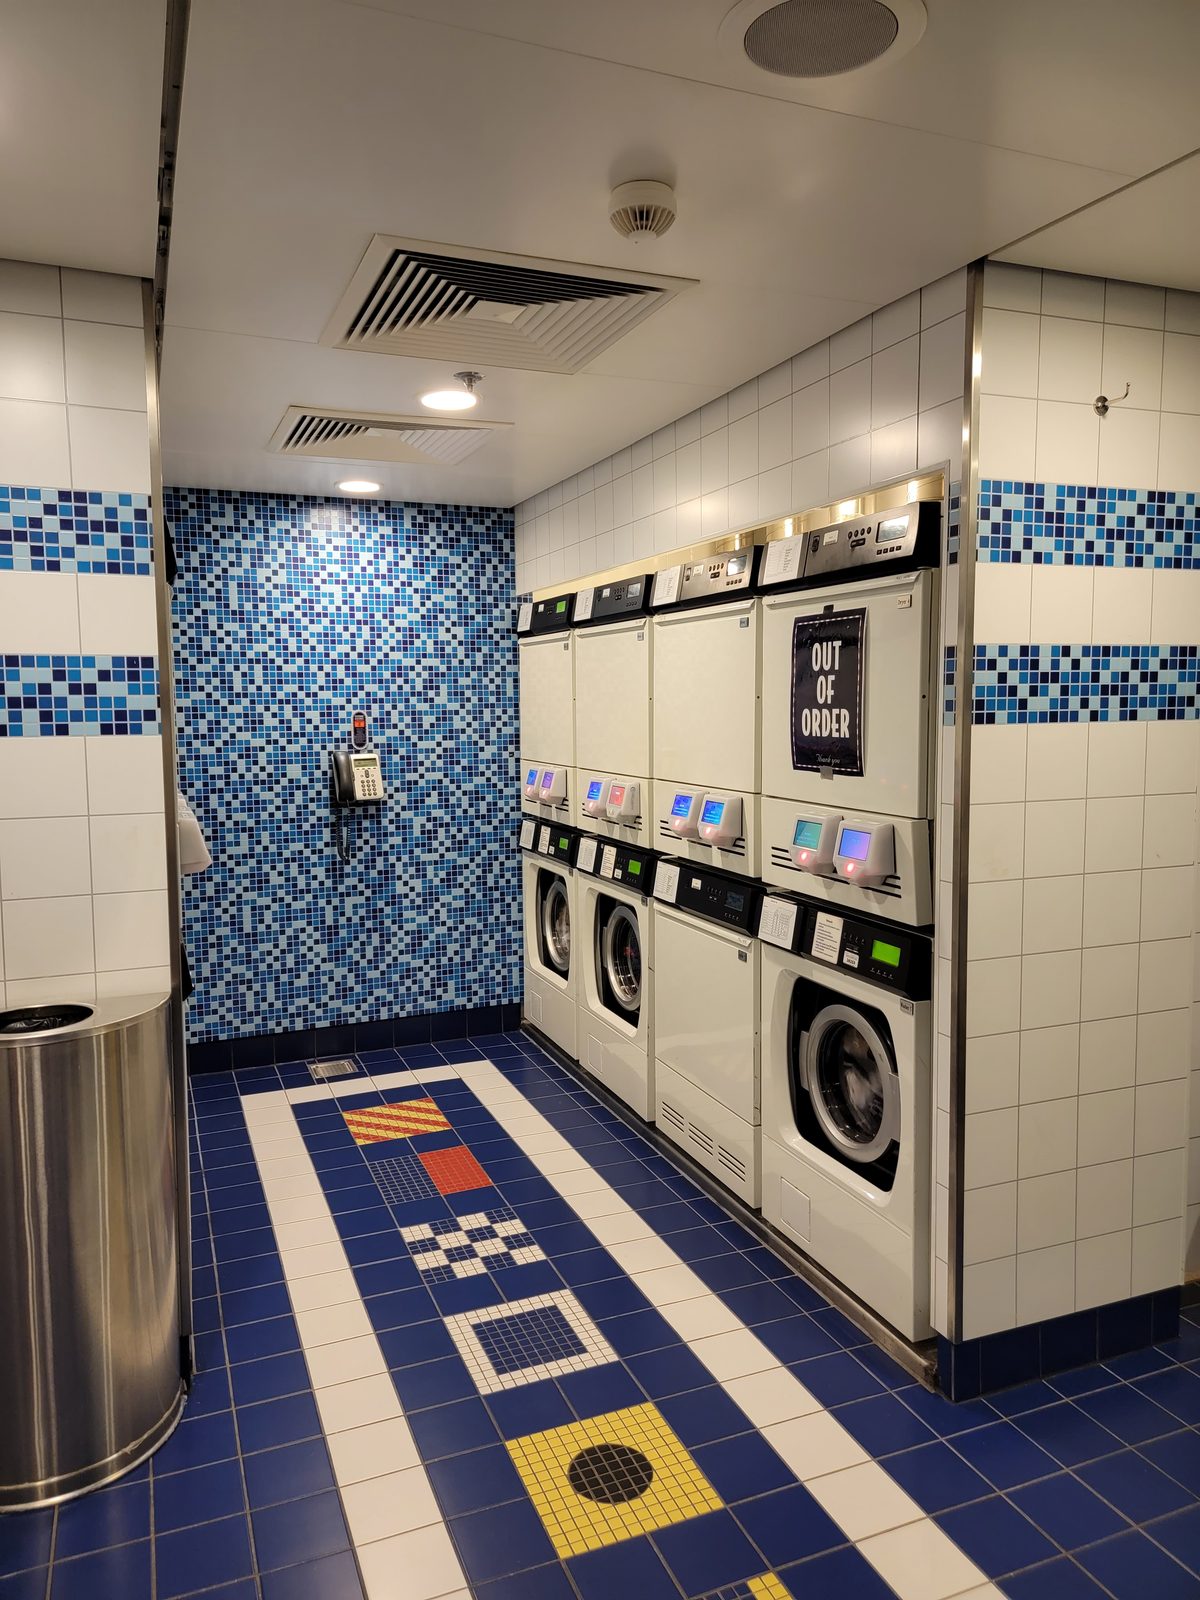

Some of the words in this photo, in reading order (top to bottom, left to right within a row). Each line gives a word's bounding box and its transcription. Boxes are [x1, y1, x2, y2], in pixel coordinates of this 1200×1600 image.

[811, 640, 842, 672] OUT
[816, 675, 836, 704] OF
[801, 708, 850, 739] ORDER
[815, 753, 831, 763] Thank
[831, 758, 841, 766] you
